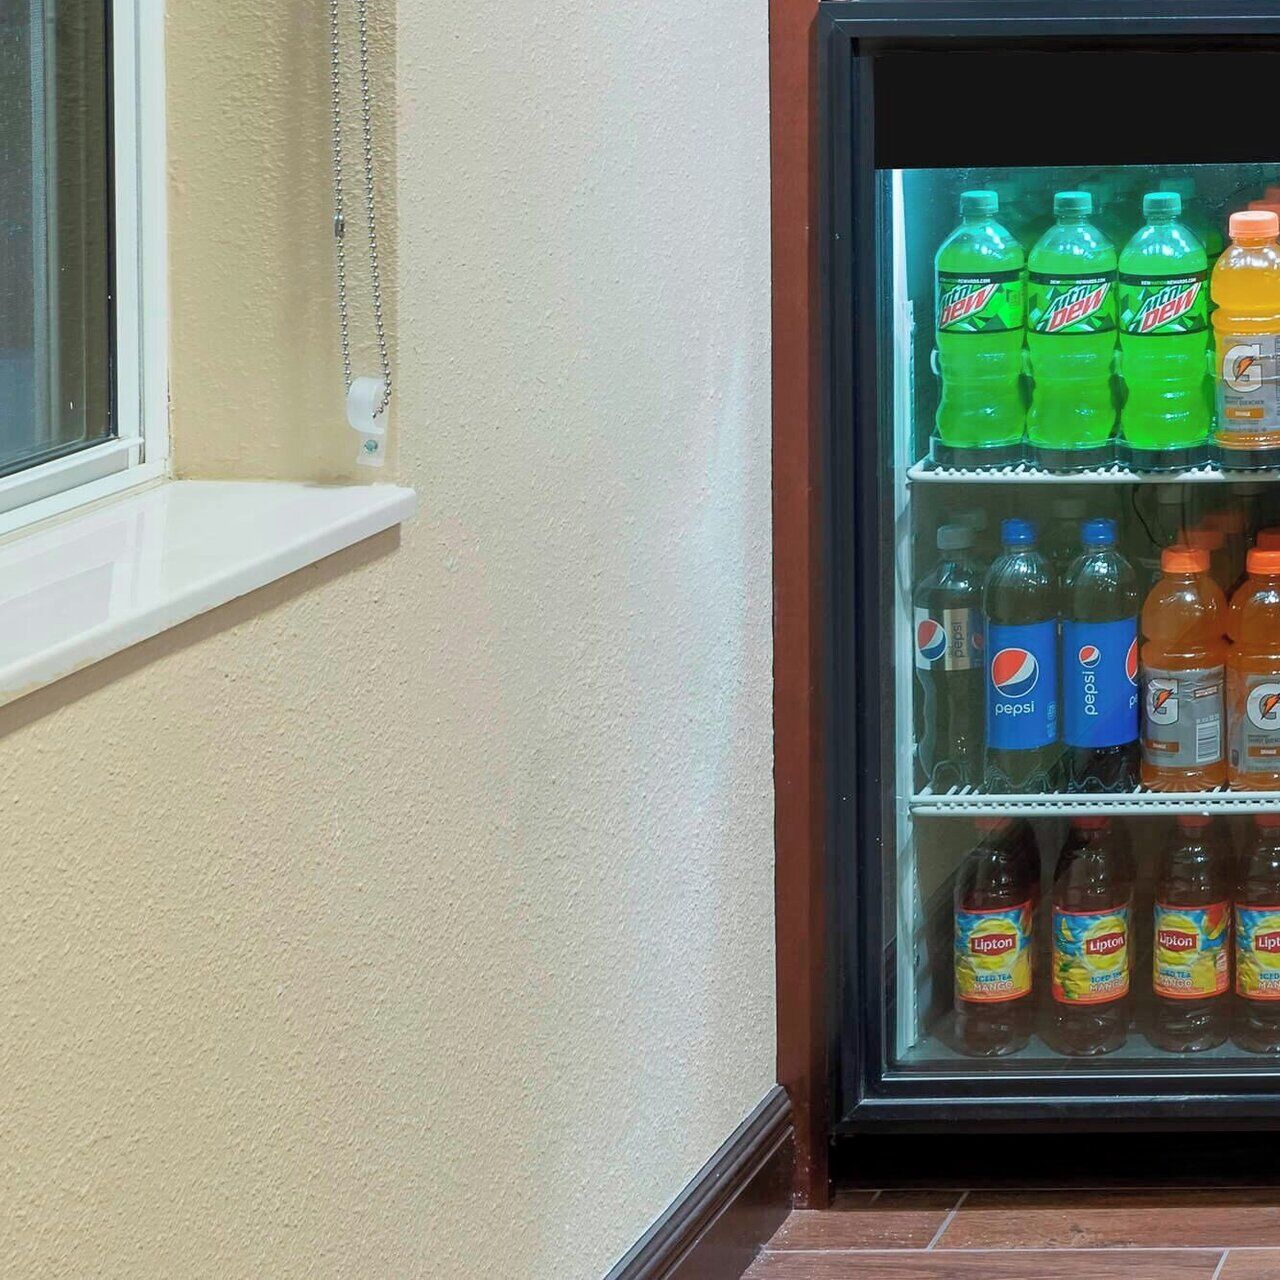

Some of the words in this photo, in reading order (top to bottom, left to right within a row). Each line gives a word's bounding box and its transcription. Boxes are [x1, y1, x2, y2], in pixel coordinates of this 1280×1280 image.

[1084, 670, 1098, 715] pepsi
[995, 701, 1035, 716] pepsi
[974, 936, 1013, 953] Lipton
[1090, 934, 1125, 952] Lipton
[1159, 933, 1193, 948] Lipton
[975, 974, 996, 983] ICED
[997, 973, 1013, 981] TEA
[973, 980, 1014, 992] MANGO
